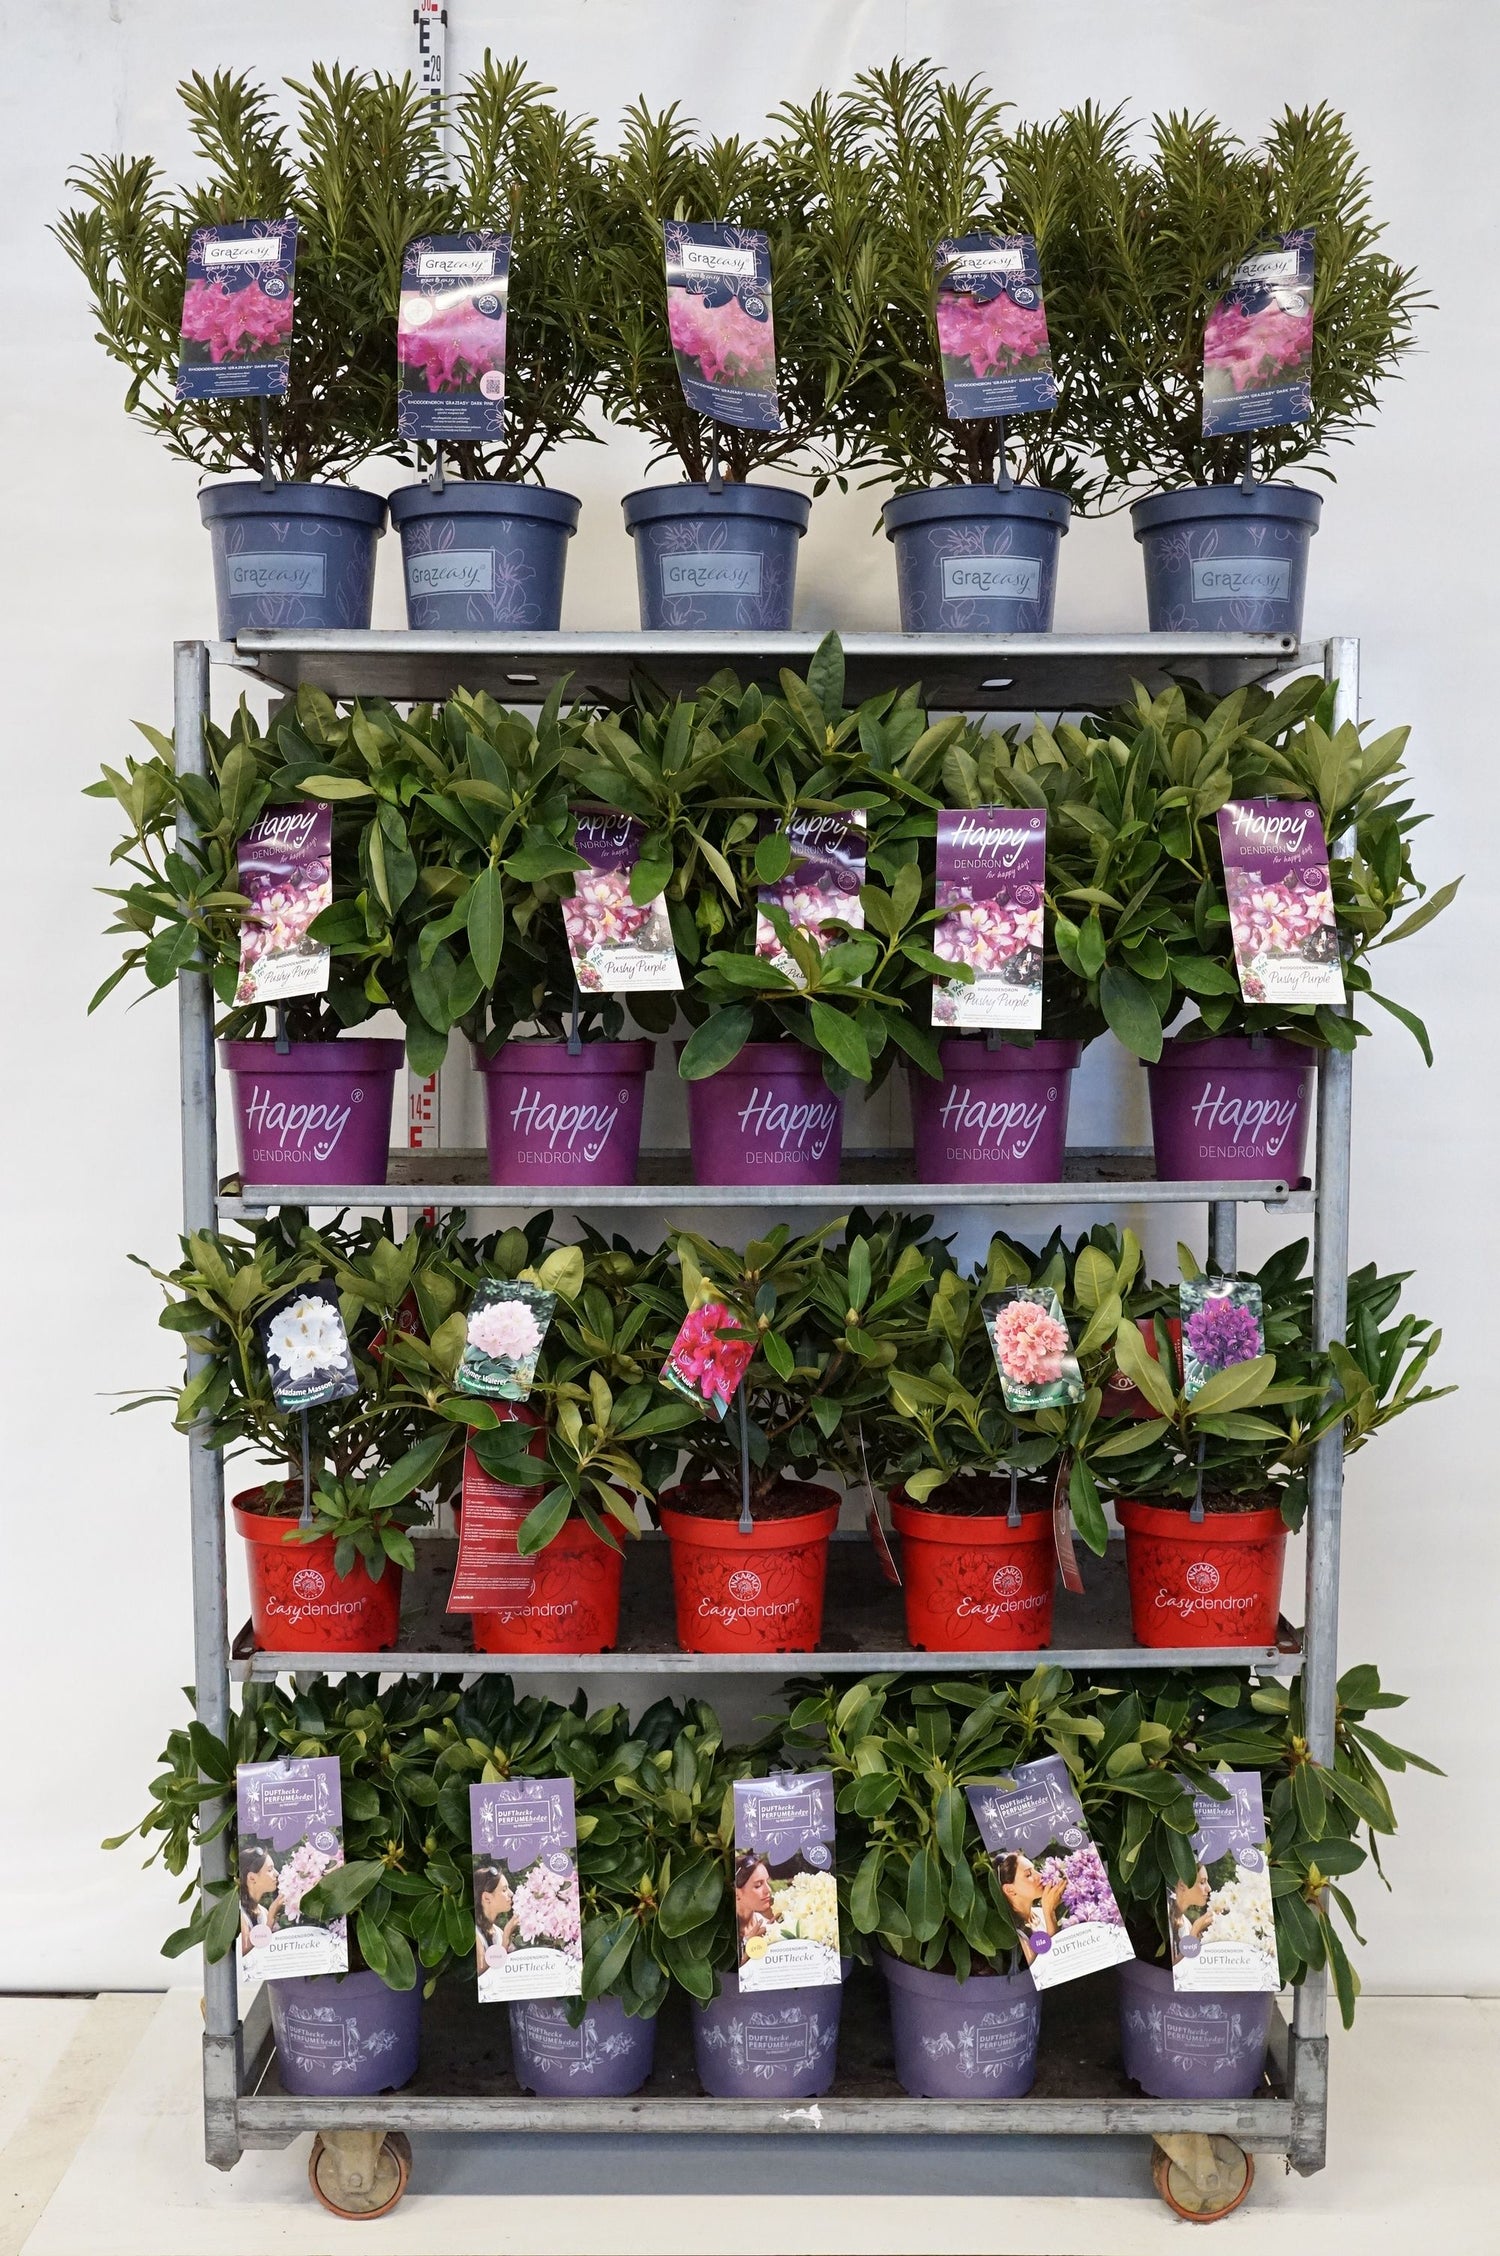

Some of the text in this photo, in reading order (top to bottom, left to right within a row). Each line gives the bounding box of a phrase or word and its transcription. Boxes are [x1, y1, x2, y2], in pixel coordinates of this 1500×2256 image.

[430, 55, 441, 82] 29
[210, 246, 270, 260] Grazeasy
[688, 252, 745, 270] Grazeasy
[425, 258, 484, 272] Grazeasy
[1238, 262, 1287, 276] razeasy
[234, 564, 312, 589] Grazeasy
[412, 564, 480, 588] Grazeasy
[670, 566, 749, 588] Grazeasy
[952, 569, 1030, 593] Grazeasy
[1202, 572, 1280, 594] Grazeasy
[250, 812, 318, 848] Happy
[578, 814, 632, 847] appy
[1232, 806, 1307, 852] Happy
[952, 816, 1031, 867] Happy
[1240, 846, 1286, 855] DENDRON
[252, 842, 293, 860] DENDRON
[1273, 855, 1281, 864] for
[954, 859, 1001, 869] DENDRON
[986, 870, 994, 879] for
[997, 868, 1016, 879] happy
[264, 964, 320, 987] Pushy Purple
[604, 960, 667, 979] Pushy Purple
[1268, 971, 1331, 990] Pushy Purple
[964, 992, 1030, 1013] Pushy Purple
[410, 1094, 422, 1120] 14
[246, 1086, 352, 1161] Happy
[510, 1087, 619, 1162] Happy
[738, 1087, 837, 1160] Happy
[940, 1084, 1047, 1159] Happy
[1192, 1082, 1297, 1156] Happy
[252, 1148, 312, 1163] DENDRON
[518, 1150, 581, 1164] DENDRON
[746, 1150, 810, 1164] DENDRON
[946, 1148, 1010, 1161] DENDRON
[1200, 1146, 1264, 1158] DENDRON
[294, 1571, 323, 1588] INKARHO
[730, 1573, 760, 1589] INKARHO
[994, 1567, 1022, 1585] INKARHO
[1188, 1564, 1218, 1580] INKARHO
[266, 1596, 361, 1624] Easydendron
[698, 1598, 794, 1625] Easydendron
[956, 1595, 1047, 1623] Easydendron
[1155, 1588, 1253, 1618] Easydendron
[264, 1788, 299, 1796] DUFThecke
[264, 1794, 314, 1803] PERFUMEhedge
[761, 1804, 795, 1812] DUFThecke
[1000, 1795, 1033, 1810] DUFThecke
[1002, 1796, 1049, 1816] PERFUMEhedge
[498, 1809, 533, 1818] DUFThecke
[498, 1815, 548, 1824] PERFUMEhedge
[762, 1810, 809, 1819] PERFUMEhedge
[1196, 1808, 1235, 1816] RFUMEhedge
[269, 1940, 320, 1952] DUFThecke
[1052, 1935, 1101, 1957] DUFThecke
[505, 1962, 556, 1973] DUFThecke
[765, 1953, 814, 1965] DUFThecke
[1200, 1955, 1251, 1965] DUFThecke
[748, 2034, 790, 2042] DUFThecke
